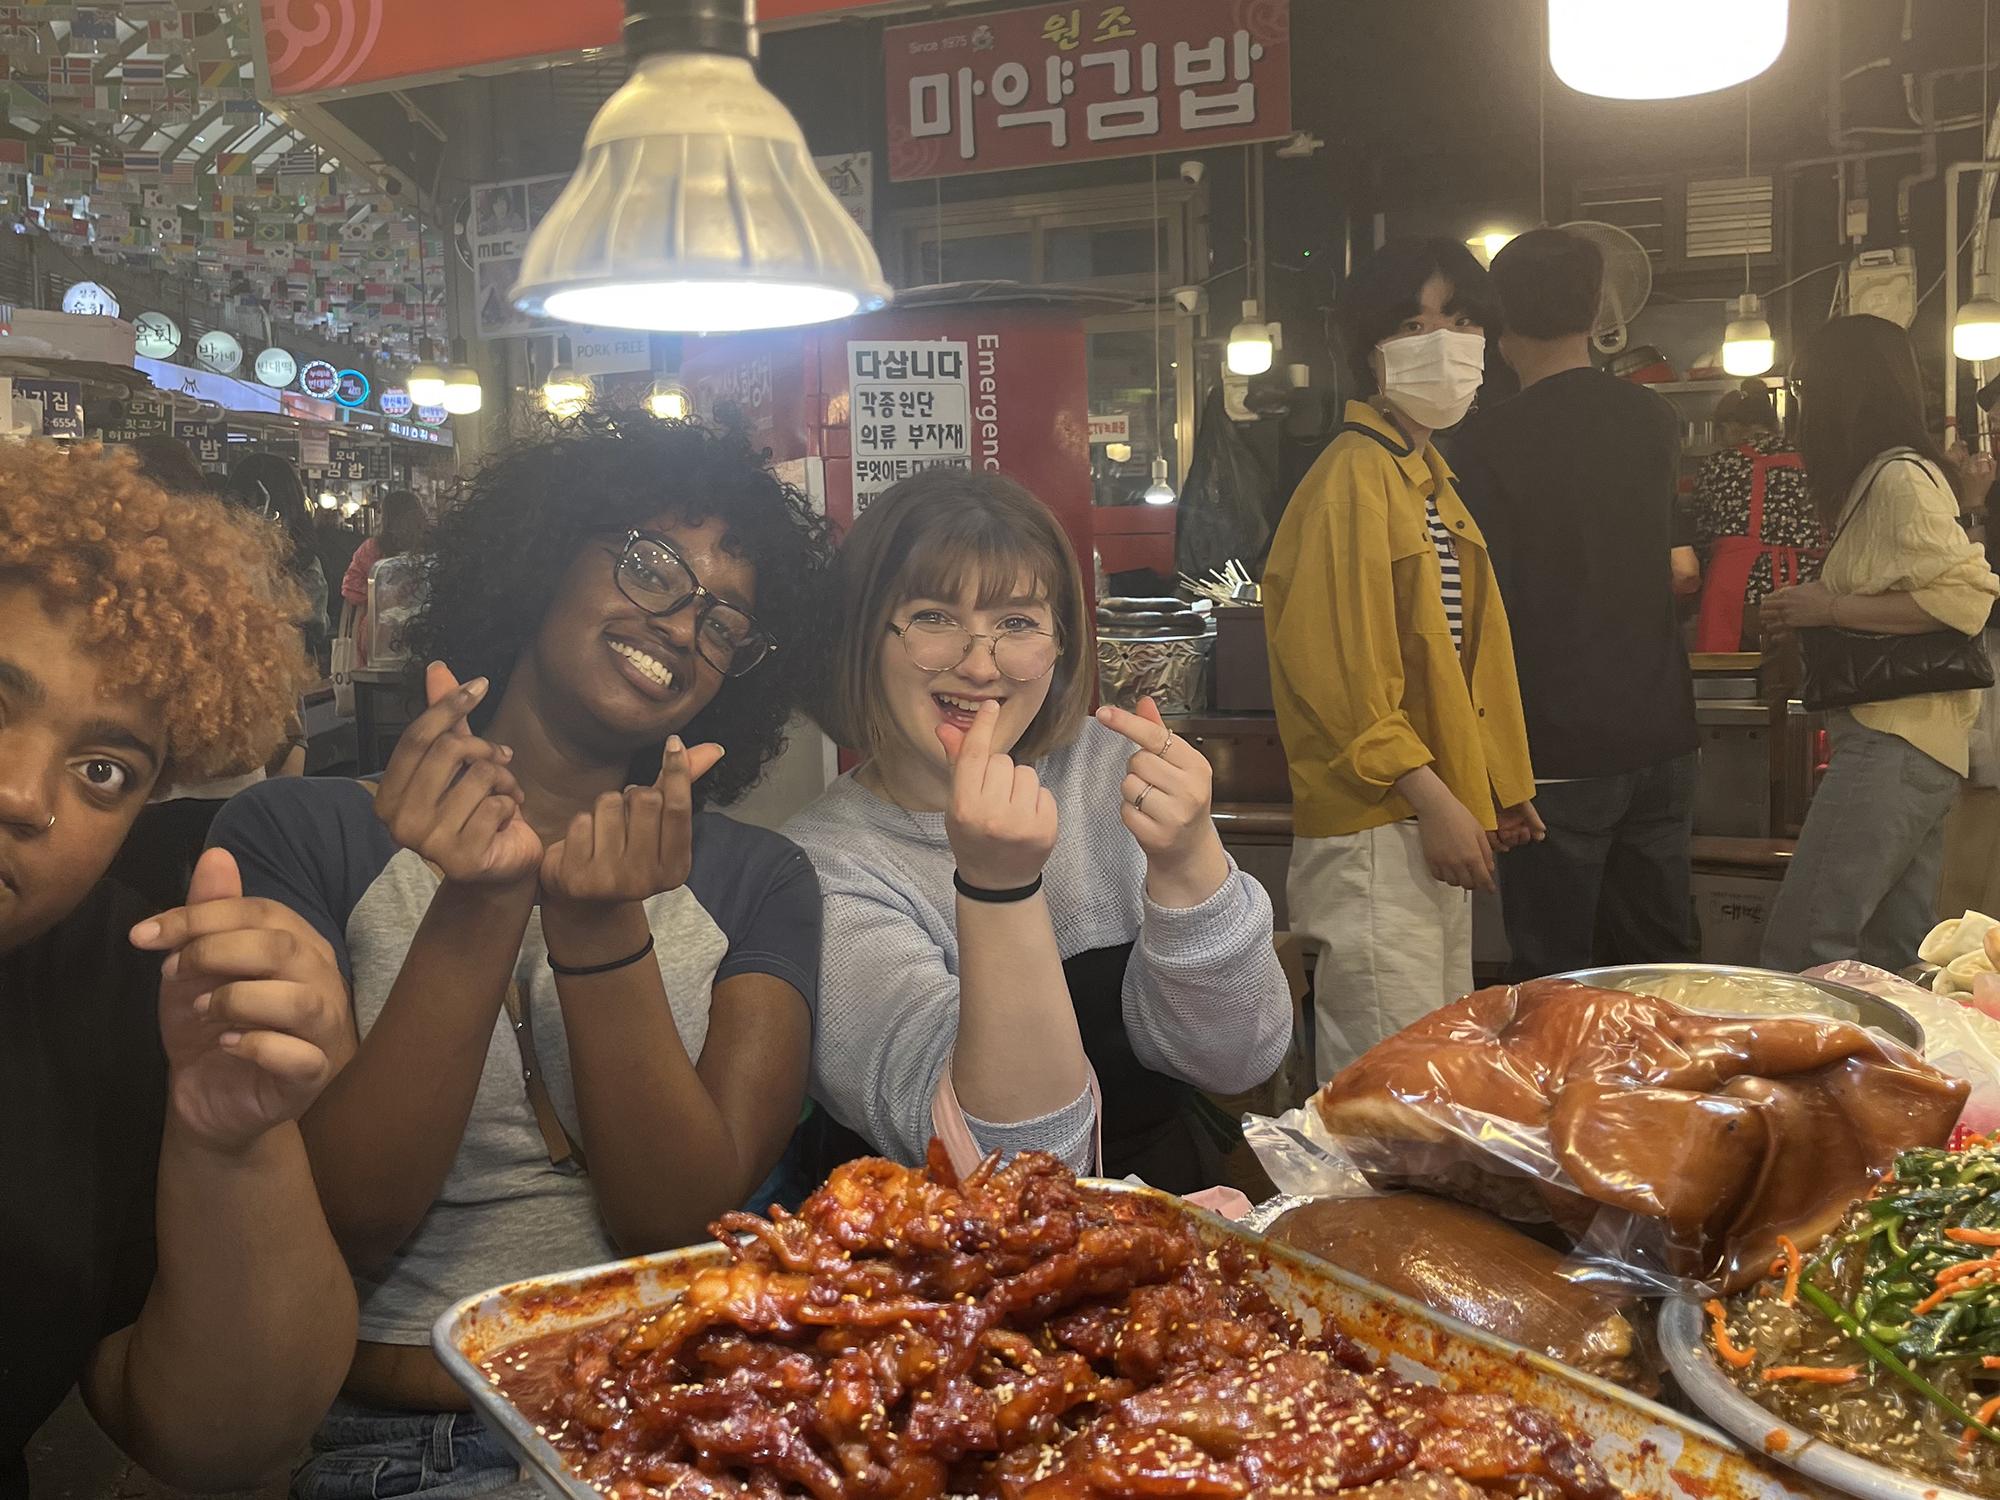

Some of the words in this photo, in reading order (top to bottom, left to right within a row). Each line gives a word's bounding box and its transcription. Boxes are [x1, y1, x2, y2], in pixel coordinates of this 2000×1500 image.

[1041, 7, 1137, 51] 원조
[909, 41, 938, 55] Since
[909, 30, 1263, 159] 마약김밥
[478, 240, 514, 258] MBC
[199, 343, 236, 364] 박가네
[577, 343, 610, 358] PORK
[615, 340, 645, 354] FREE
[856, 350, 963, 380] 다삽니다
[861, 424, 896, 449] 의류
[908, 423, 963, 449] 부자재
[327, 461, 366, 479] 김밥
